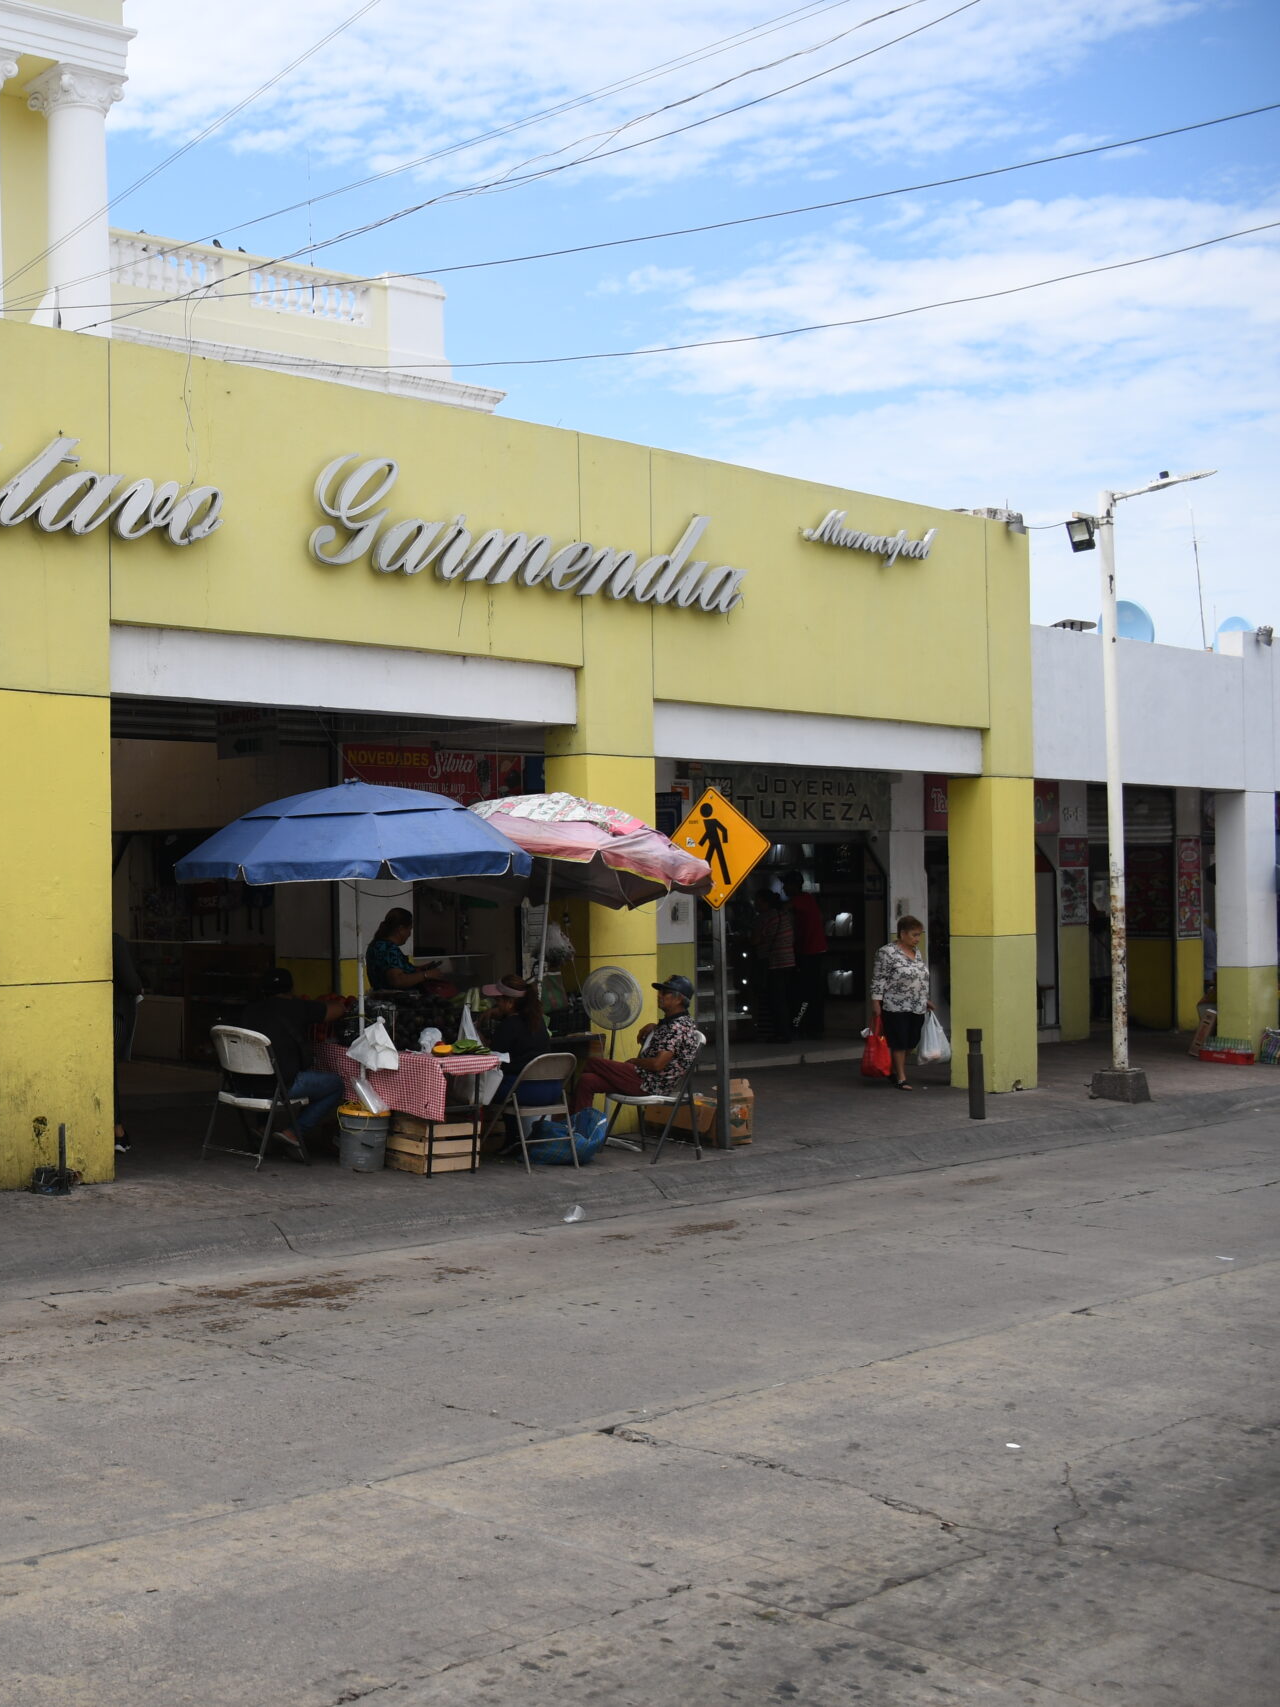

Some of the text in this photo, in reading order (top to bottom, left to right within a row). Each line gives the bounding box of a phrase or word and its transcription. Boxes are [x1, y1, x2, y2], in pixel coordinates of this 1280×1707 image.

[308, 452, 749, 615] Garmendia
[347, 750, 474, 780] NOVEDADES Silvia
[413, 782, 440, 793] CONTROL
[757, 775, 857, 797] JOYERIA
[737, 796, 873, 821] TURKEZA
